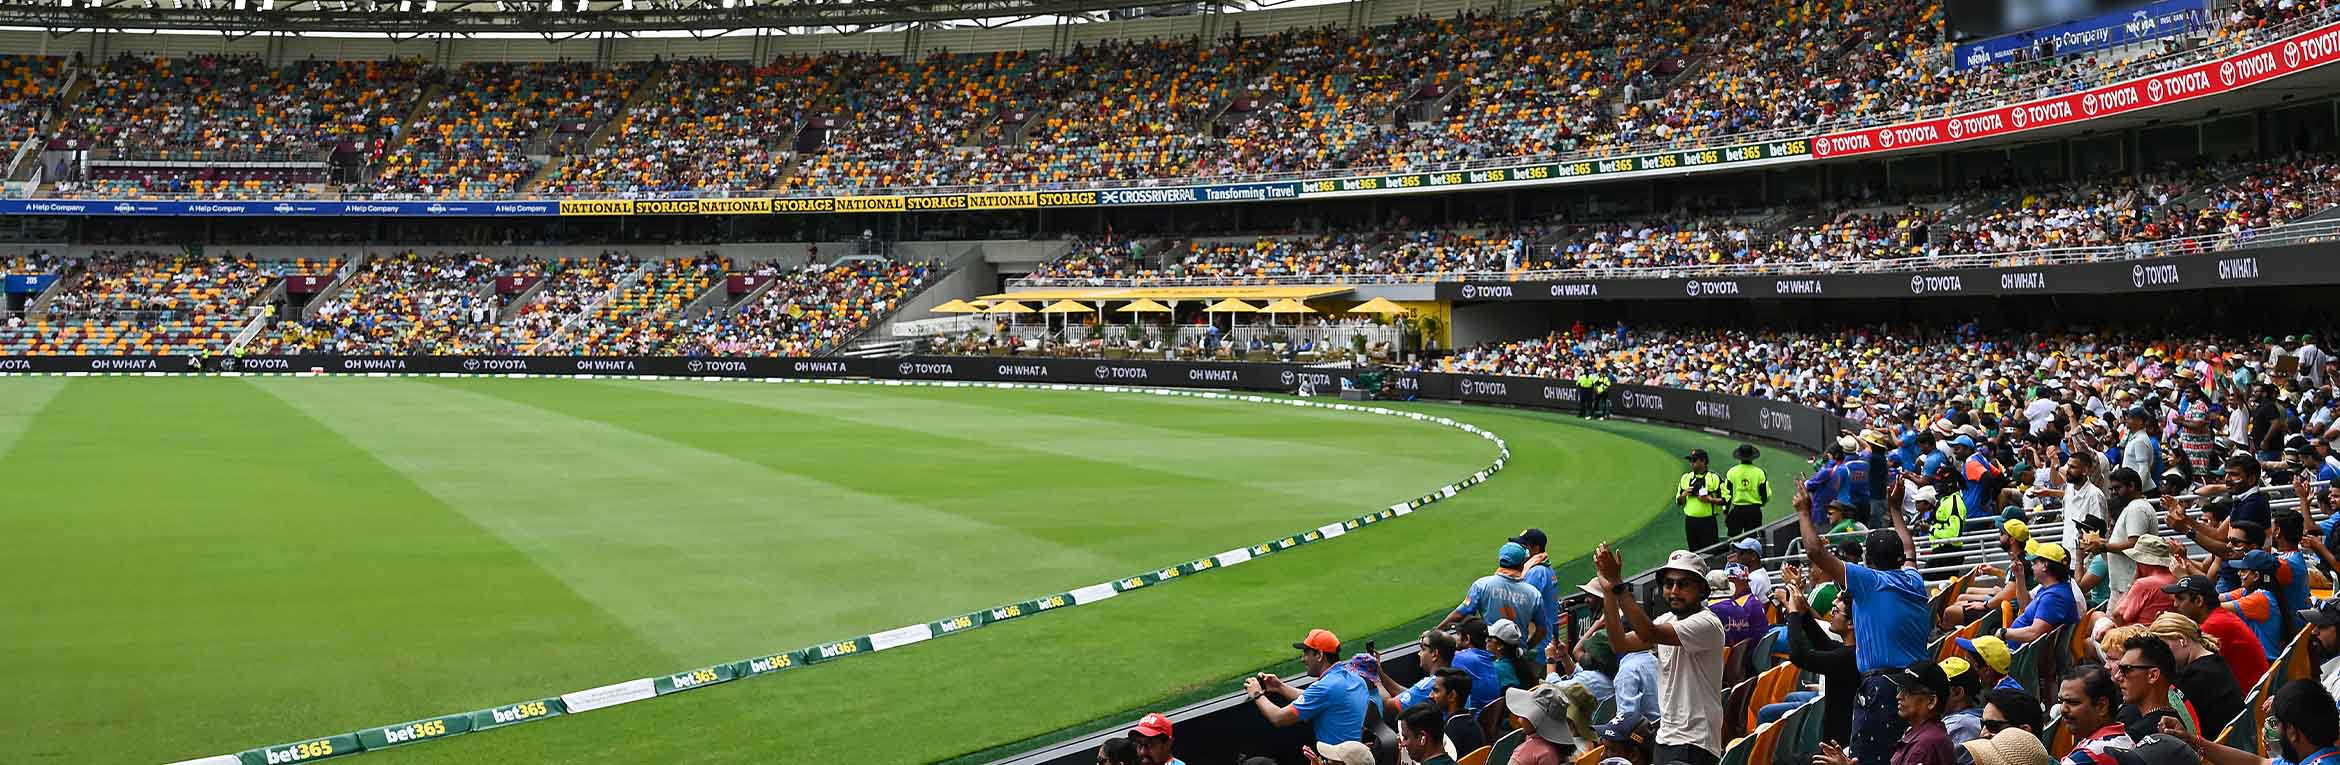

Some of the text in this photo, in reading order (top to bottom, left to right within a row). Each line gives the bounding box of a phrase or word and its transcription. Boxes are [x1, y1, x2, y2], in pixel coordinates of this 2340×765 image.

[2064, 27, 2108, 46] Company
[2236, 52, 2276, 79] TOYOTA
[2164, 72, 2210, 96] TOYOTA
[2099, 87, 2138, 110] TOYOTA
[2028, 102, 2072, 122] TOYOTA
[1964, 115, 2003, 134] TOYOTA
[1896, 126, 1938, 142] TOYOTA
[1770, 141, 1805, 157] bet365
[1832, 138, 1870, 152] TOYOTA
[1684, 150, 1718, 166] bet365
[1725, 146, 1760, 161] bet365
[1599, 159, 1632, 173] bet365
[1641, 154, 1676, 170] bet365
[1470, 170, 1504, 183] bet365
[1513, 167, 1548, 180] bet365
[1559, 163, 1591, 177] bet365
[1302, 180, 1335, 193] bet365
[1344, 178, 1376, 190] bet365
[1386, 176, 1420, 188] bet365
[1430, 174, 1462, 185] bet365
[970, 193, 1095, 207] NATIONAL STORAGE
[1206, 185, 1294, 202] Transforming Travel
[33, 204, 48, 212] Help
[49, 204, 85, 212] Company
[196, 204, 210, 212] Help
[212, 204, 244, 212] Company
[352, 204, 366, 212] Help
[367, 204, 399, 212] Company
[502, 204, 515, 212] Help
[516, 204, 546, 212] Company
[562, 202, 698, 214] NATIONAL STORAGE
[700, 200, 832, 212] NATIONAL STORAGE
[837, 197, 966, 209] NATIONAL STORAGE
[2146, 265, 2178, 284] TOYOTA
[2219, 258, 2258, 280] OH WHAT A
[1776, 280, 1821, 293] OH WHAT A
[1926, 276, 1961, 292] TOYOTA
[2002, 273, 2044, 288] OH WHAT A
[1478, 286, 1512, 297] TOYOTA
[1551, 285, 1597, 296] OH WHAT A
[1702, 282, 1738, 295] TOYOTA
[92, 360, 157, 368] OH WHAT A
[242, 360, 288, 368] TOYOTA
[344, 360, 406, 369] OH WHAT A
[483, 360, 526, 369] TOYOTA
[577, 361, 635, 370] OH WHAT A
[706, 362, 746, 371] TOYOTA
[795, 362, 846, 372] OH WHAT A
[916, 364, 952, 374] TOYOTA
[999, 366, 1047, 376] OH WHAT A
[1111, 368, 1147, 378] TOYOTA
[1190, 370, 1238, 381] OH WHAT A
[1474, 382, 1506, 395] TOYOTA
[1544, 386, 1554, 398] OH
[1555, 387, 1576, 401] WHAT
[1635, 393, 1663, 410] TOYOTA
[1696, 399, 1706, 414] OH
[1771, 415, 1792, 433] TOYOTA
[1037, 596, 1064, 610] bet365
[992, 606, 1020, 621] bet365
[940, 616, 972, 632] bet365
[820, 640, 856, 658] bet365
[750, 655, 790, 673] bet365
[672, 668, 717, 688] bet365
[492, 702, 546, 724] bet365
[383, 720, 446, 744] bet365
[265, 740, 333, 765] bet365
